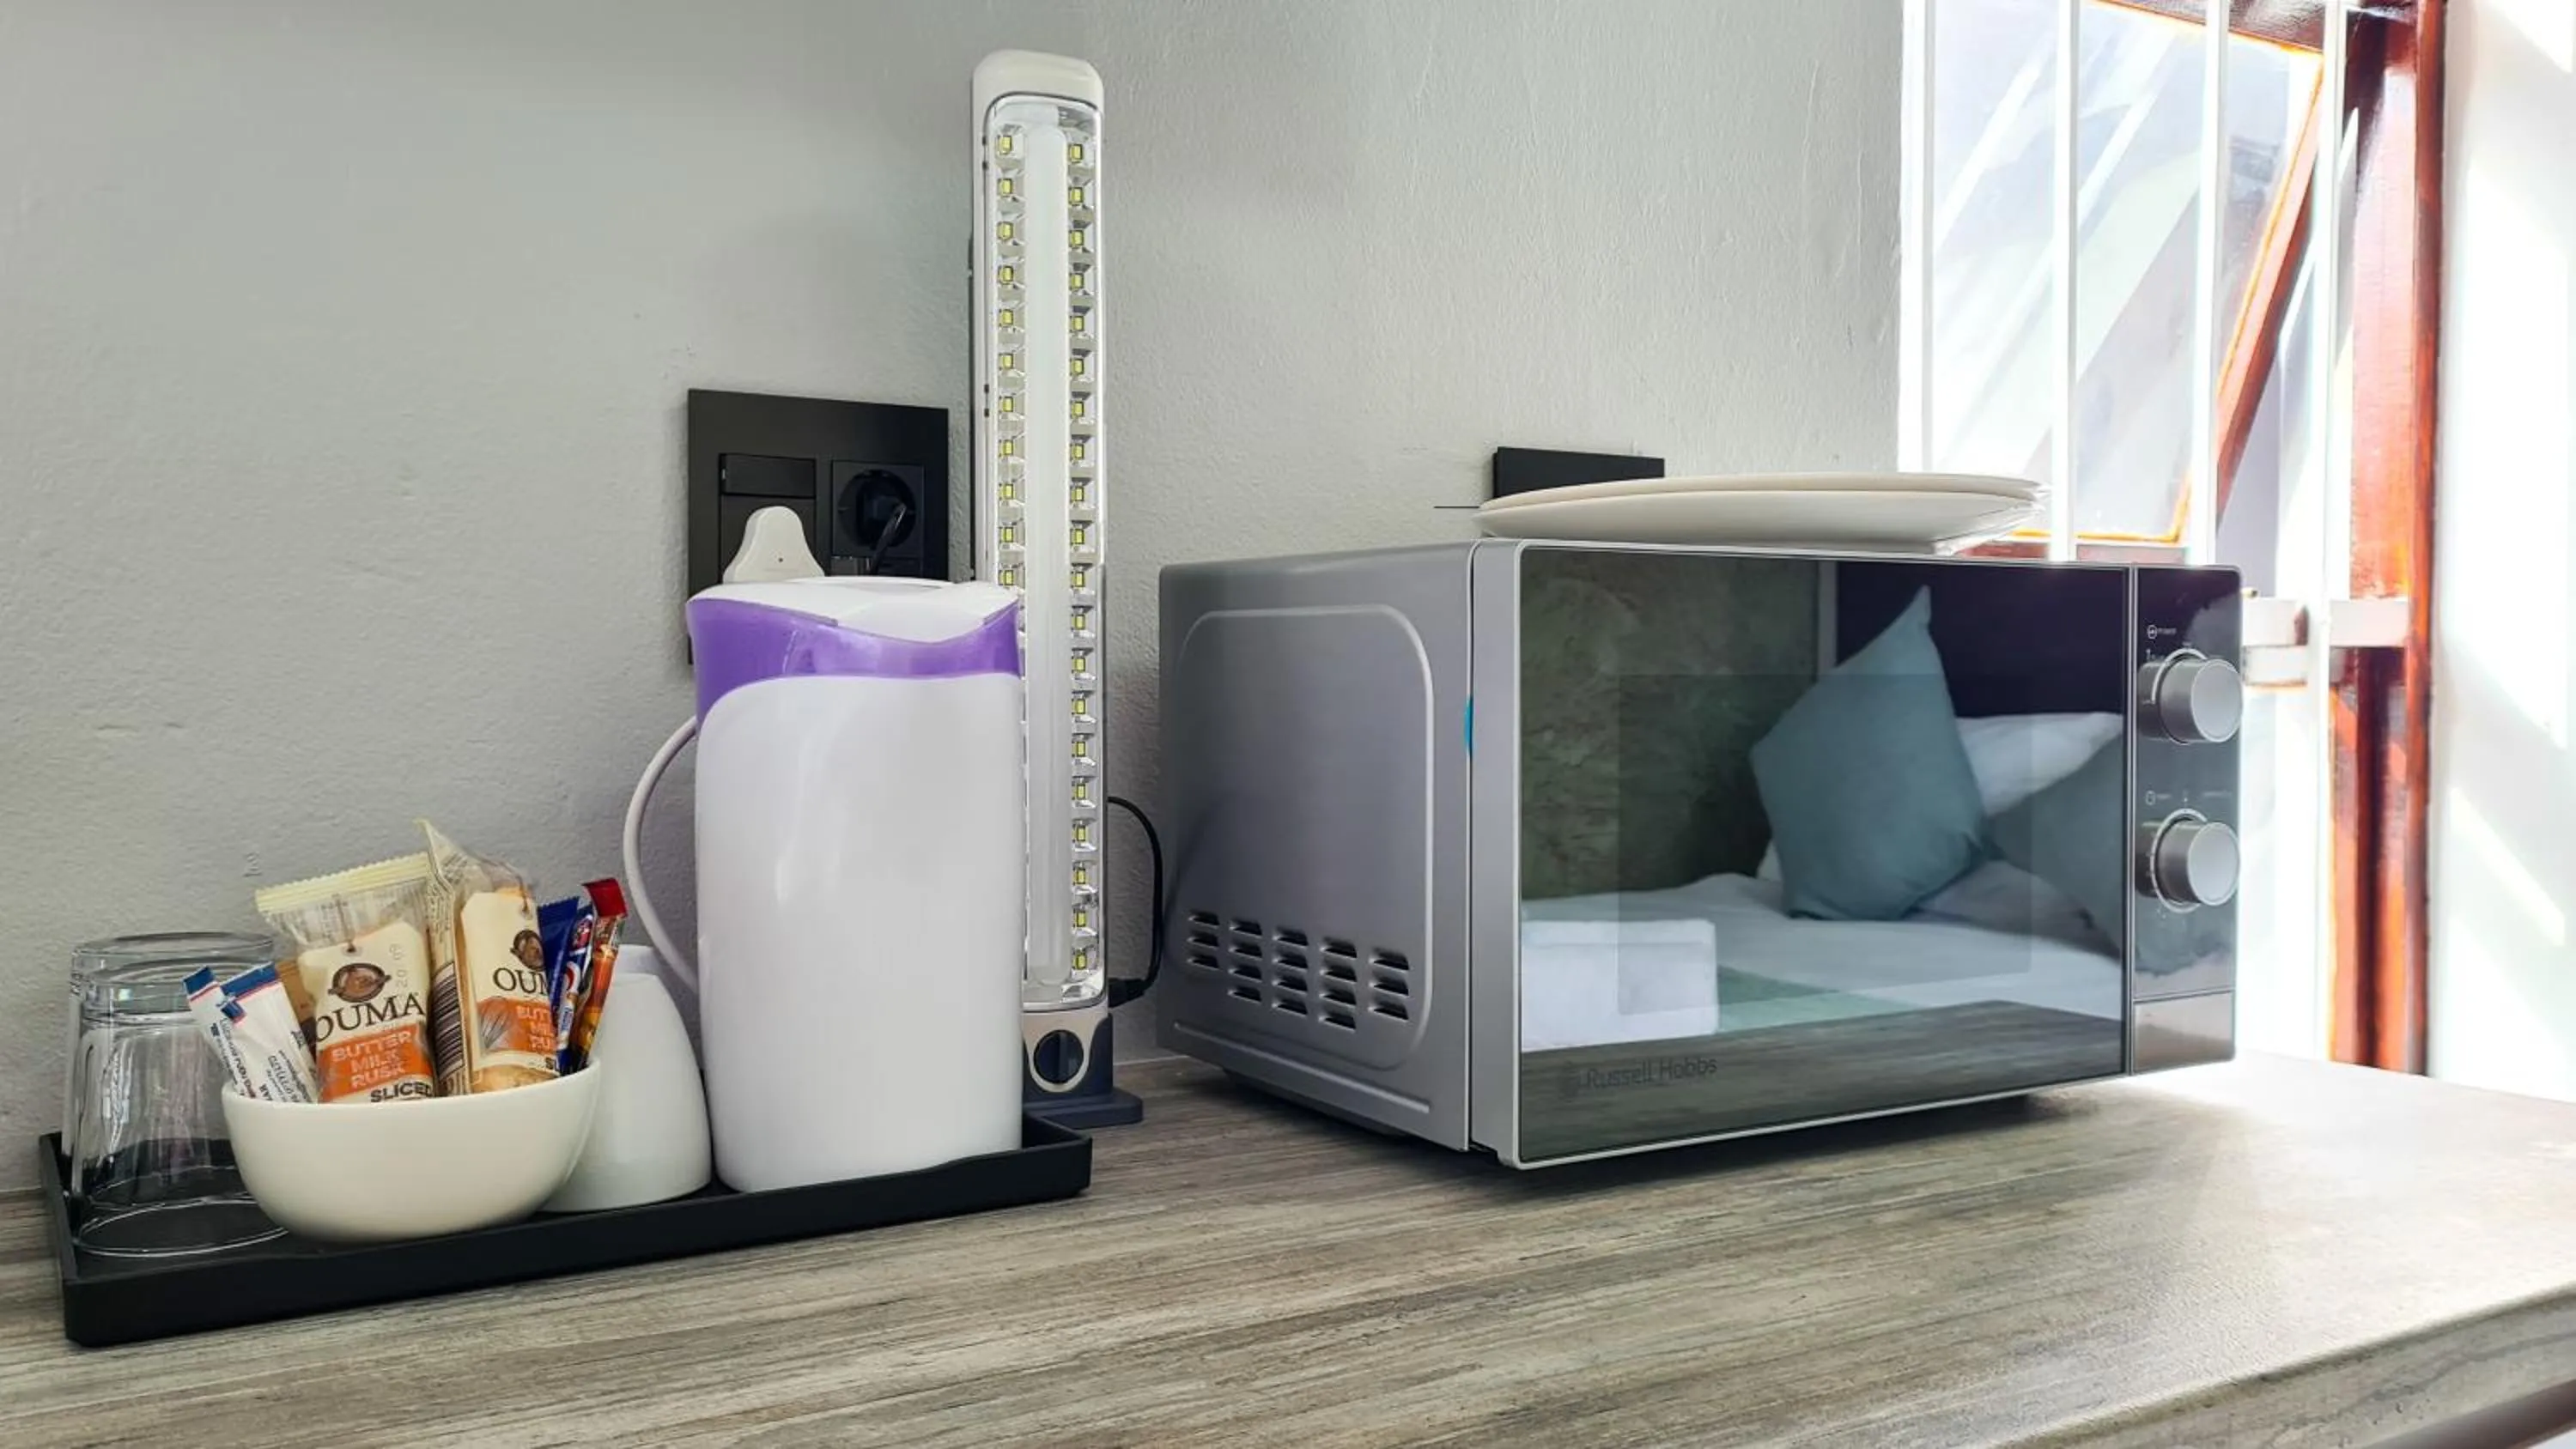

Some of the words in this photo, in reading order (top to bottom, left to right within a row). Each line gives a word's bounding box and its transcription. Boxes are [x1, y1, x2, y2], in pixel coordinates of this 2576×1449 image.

[316, 992, 426, 1042] OUMA
[332, 1031, 412, 1063] BUTTER
[1586, 1058, 1652, 1089] Russell
[1661, 1056, 1718, 1081] Hobbs
